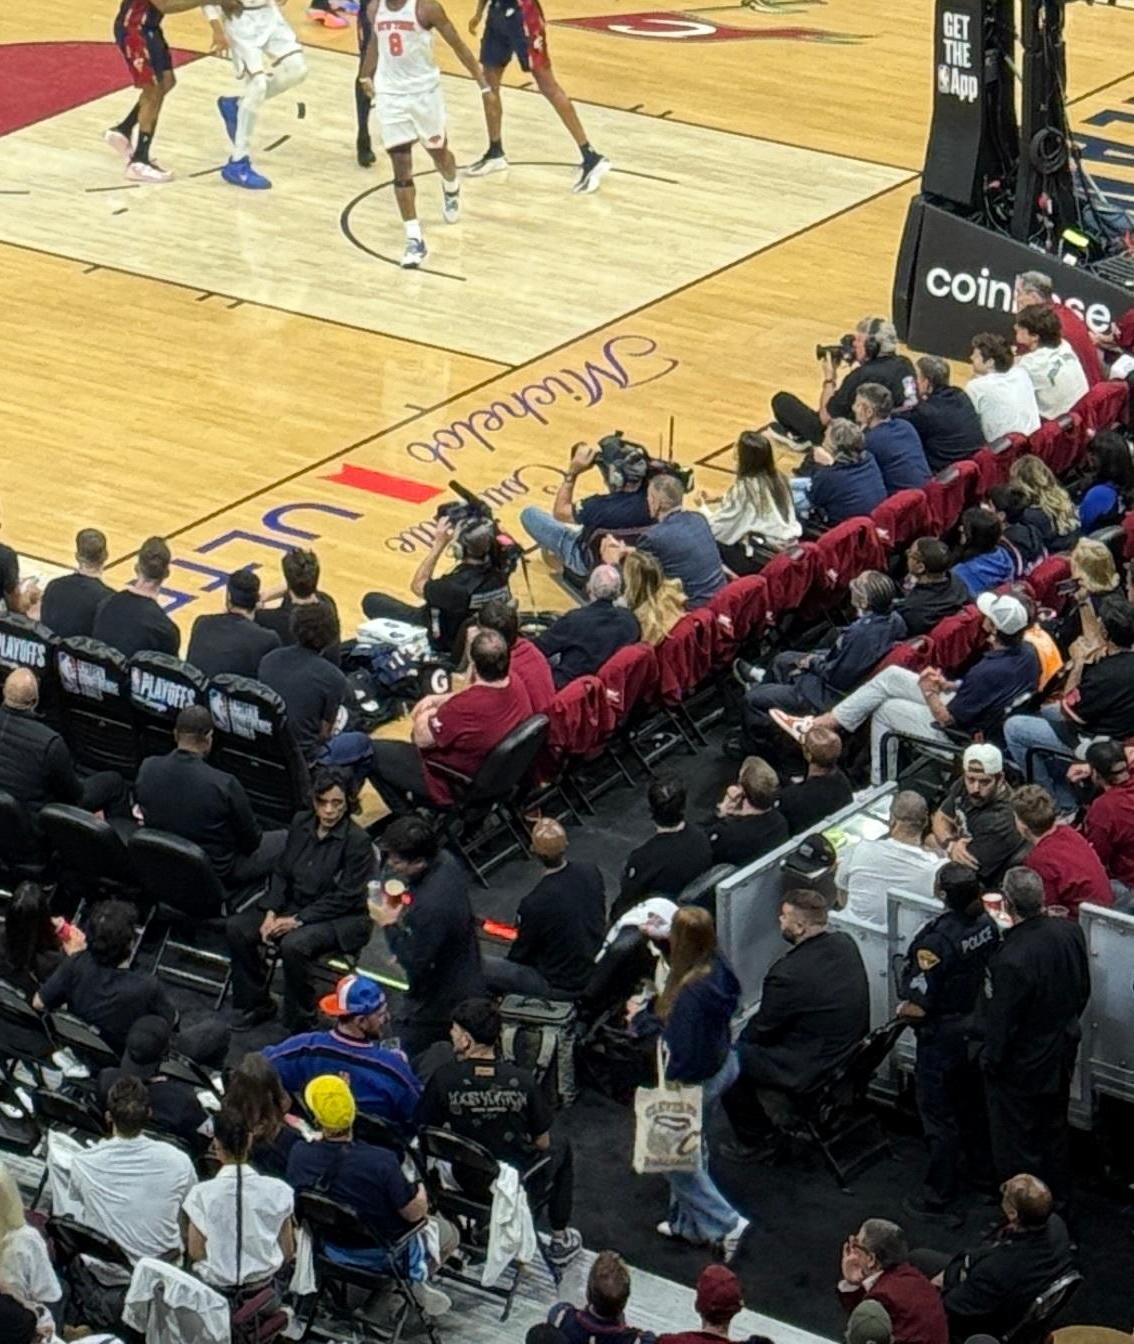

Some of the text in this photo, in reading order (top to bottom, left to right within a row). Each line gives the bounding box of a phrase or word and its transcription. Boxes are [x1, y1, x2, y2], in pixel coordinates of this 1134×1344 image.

[942, 10, 971, 42] GET
[389, 32, 404, 57] 8
[943, 39, 972, 71] THE
[950, 67, 979, 104] App
[926, 264, 1113, 336] coinse
[139, 678, 196, 710] PLAYOFFS
[961, 925, 994, 955] POLICE
